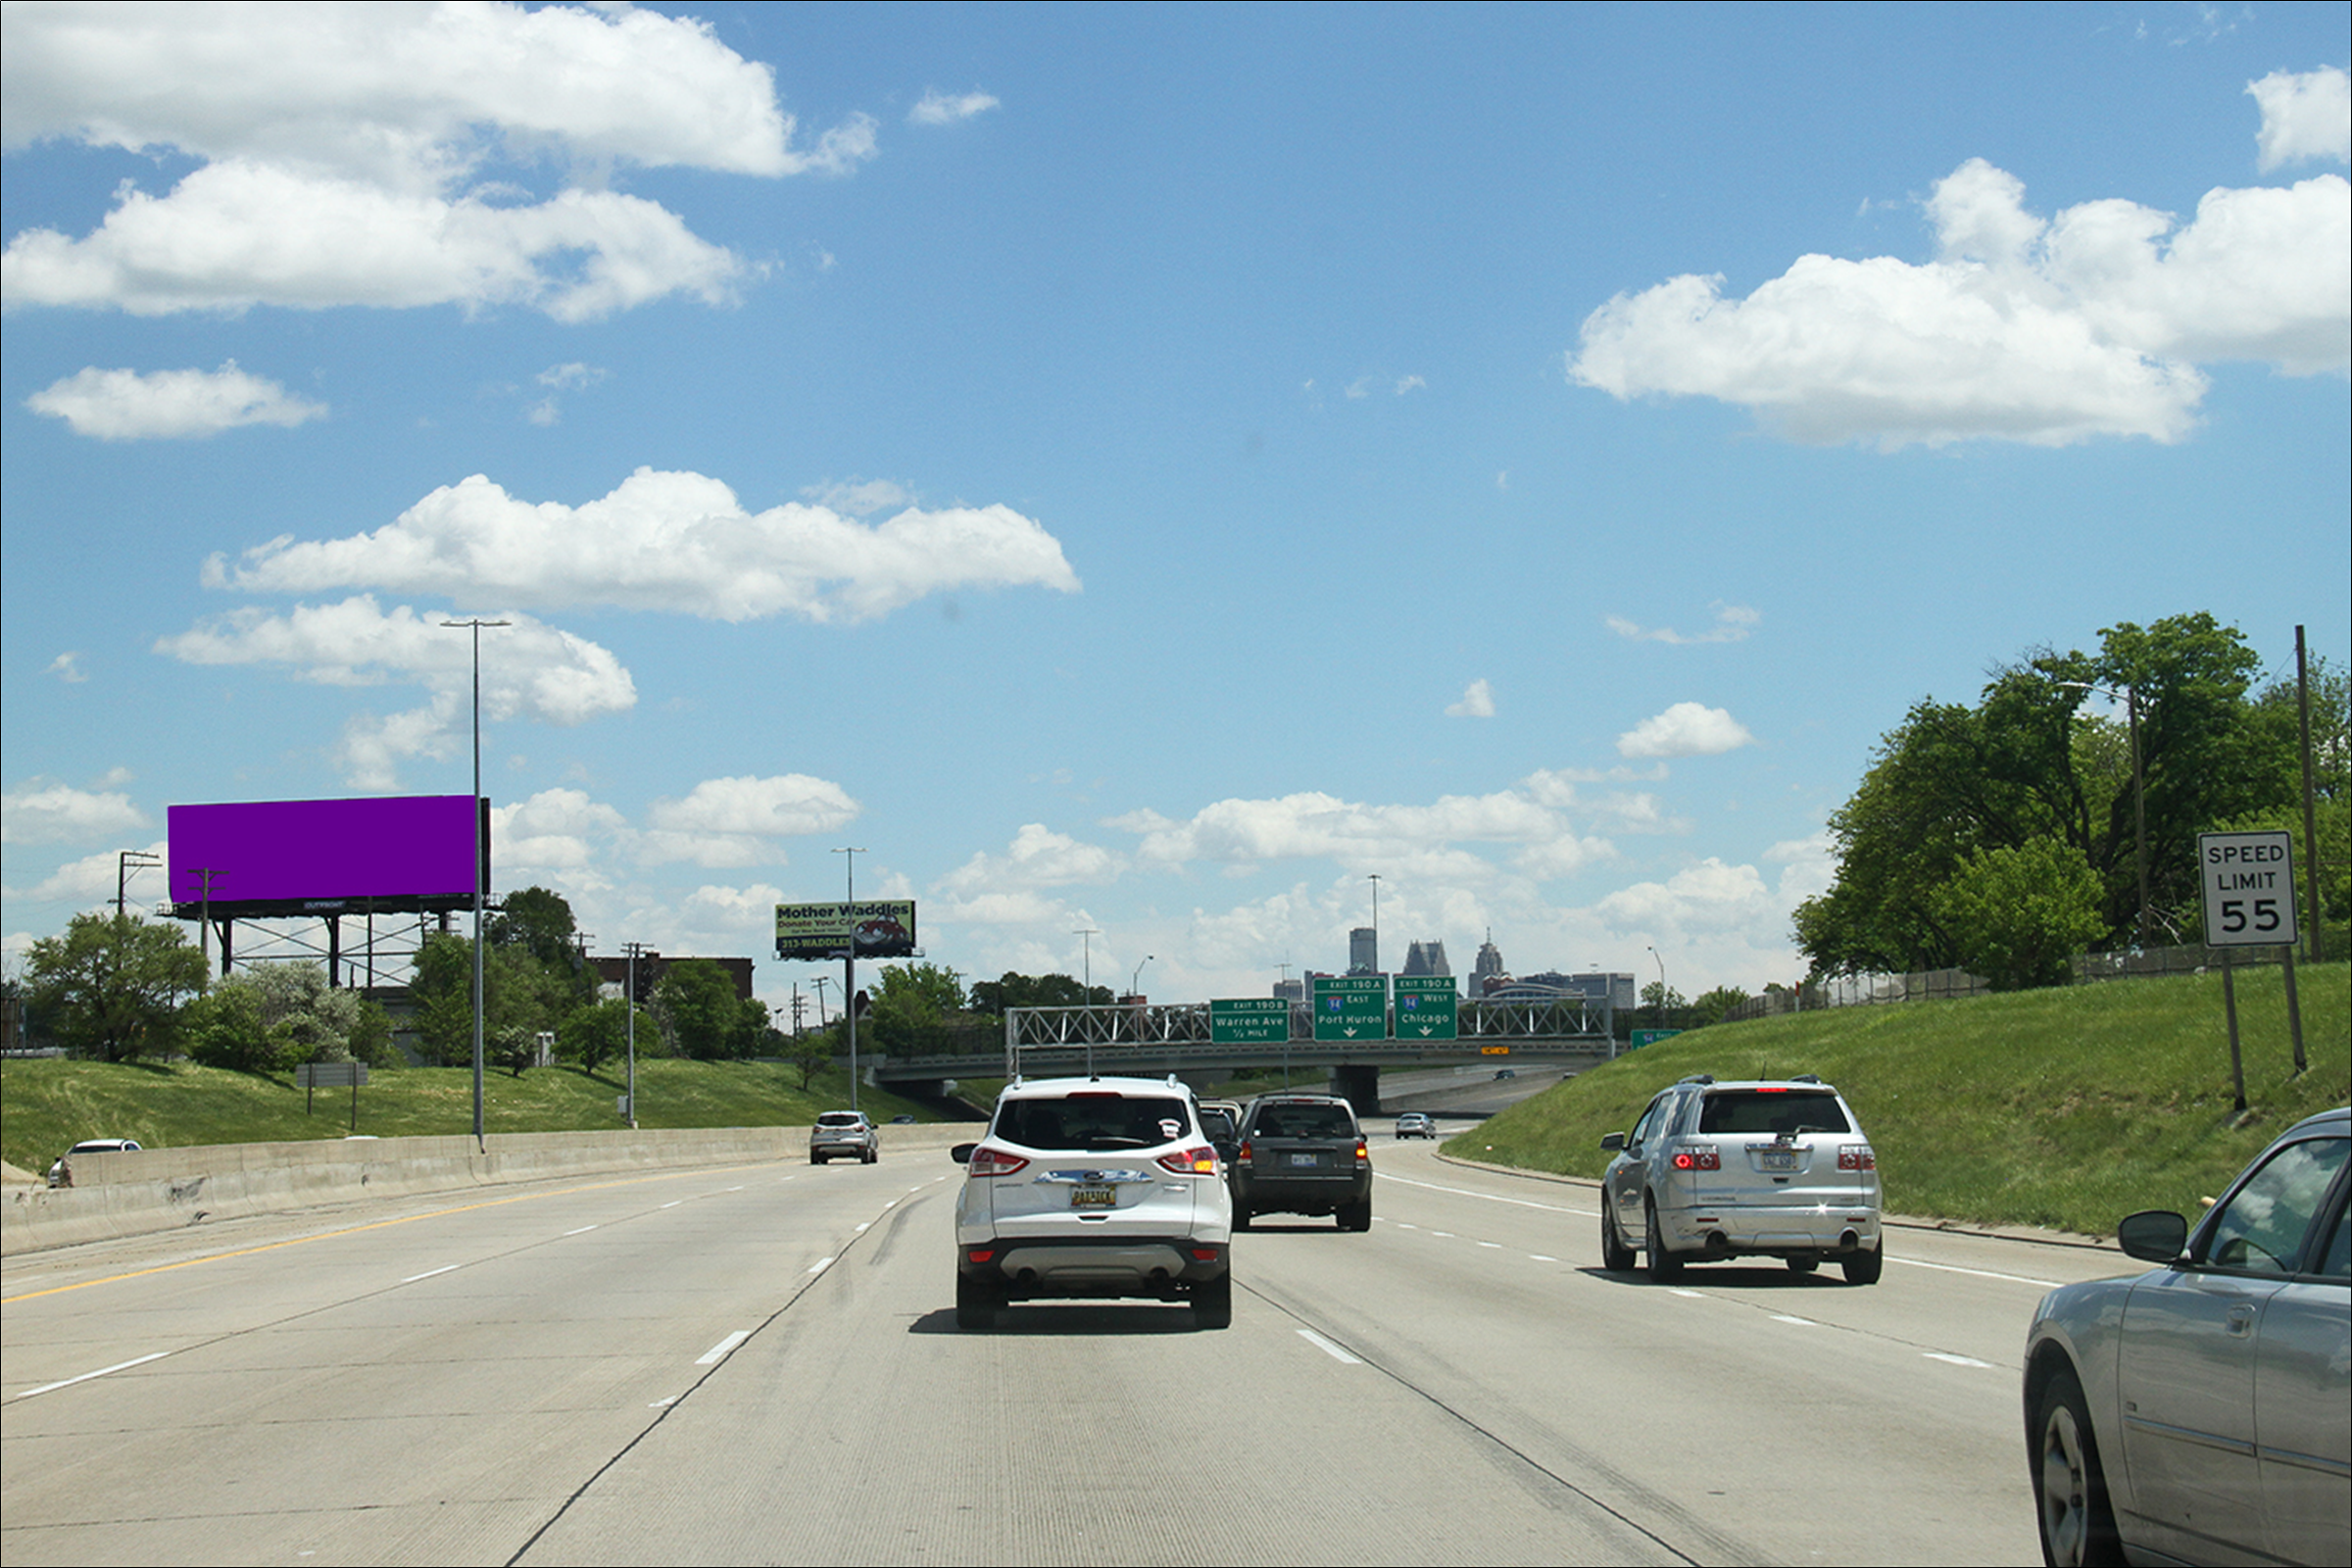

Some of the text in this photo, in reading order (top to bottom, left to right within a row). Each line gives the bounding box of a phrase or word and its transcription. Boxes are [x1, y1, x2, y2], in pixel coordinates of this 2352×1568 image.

[2208, 845, 2284, 863] SPEED
[2218, 871, 2277, 890] LIMIT
[777, 903, 909, 919] Mother Waddles
[2222, 899, 2280, 933] 55
[777, 919, 812, 928] Donate
[814, 918, 837, 927] Your
[782, 937, 850, 949] 313-WADDLES
[1330, 1000, 1341, 1008] 94
[1347, 995, 1369, 1004] EAST
[1405, 998, 1416, 1006] 94
[1423, 994, 1448, 1003] WEST
[1215, 1016, 1284, 1027] Warren Ave
[1318, 1015, 1382, 1024] Port Huron
[1401, 1013, 1449, 1025] Chicago
